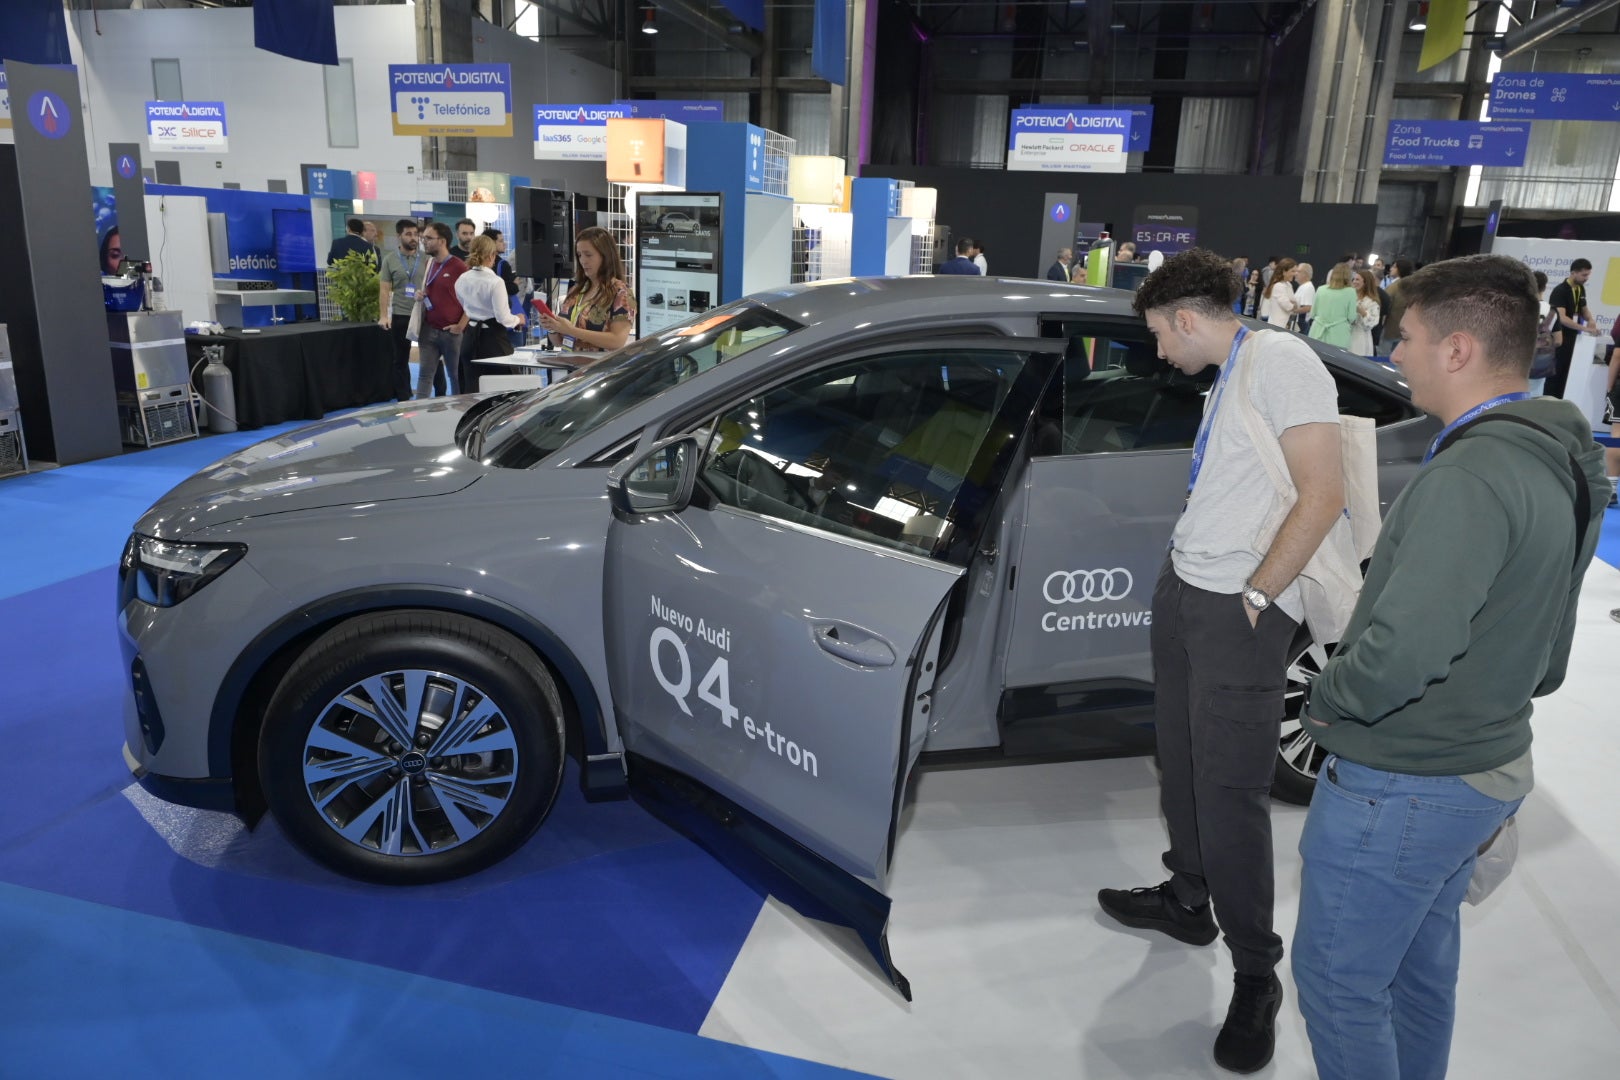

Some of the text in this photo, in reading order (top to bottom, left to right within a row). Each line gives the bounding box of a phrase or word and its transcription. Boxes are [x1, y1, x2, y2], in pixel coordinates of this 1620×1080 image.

[394, 67, 504, 85] POTENCIALDIGITAL
[1497, 76, 1545, 88] Zona de
[1495, 89, 1536, 100] Drones
[433, 103, 491, 116] Telefónica
[1492, 106, 1517, 114] Drones
[1016, 112, 1125, 128] POTENCIALDIGITAL
[1393, 124, 1422, 134] Zona
[577, 134, 602, 145] Google
[1391, 136, 1460, 147] Food Trucks
[1069, 144, 1115, 153] ORACLE
[230, 254, 277, 270] elefónic
[1522, 254, 1574, 267] Apple par
[1596, 314, 1616, 324] Ren
[651, 595, 731, 653] Nuevo Audi
[1041, 610, 1152, 633] Centrowa
[650, 626, 818, 778] Q4 e-tron
